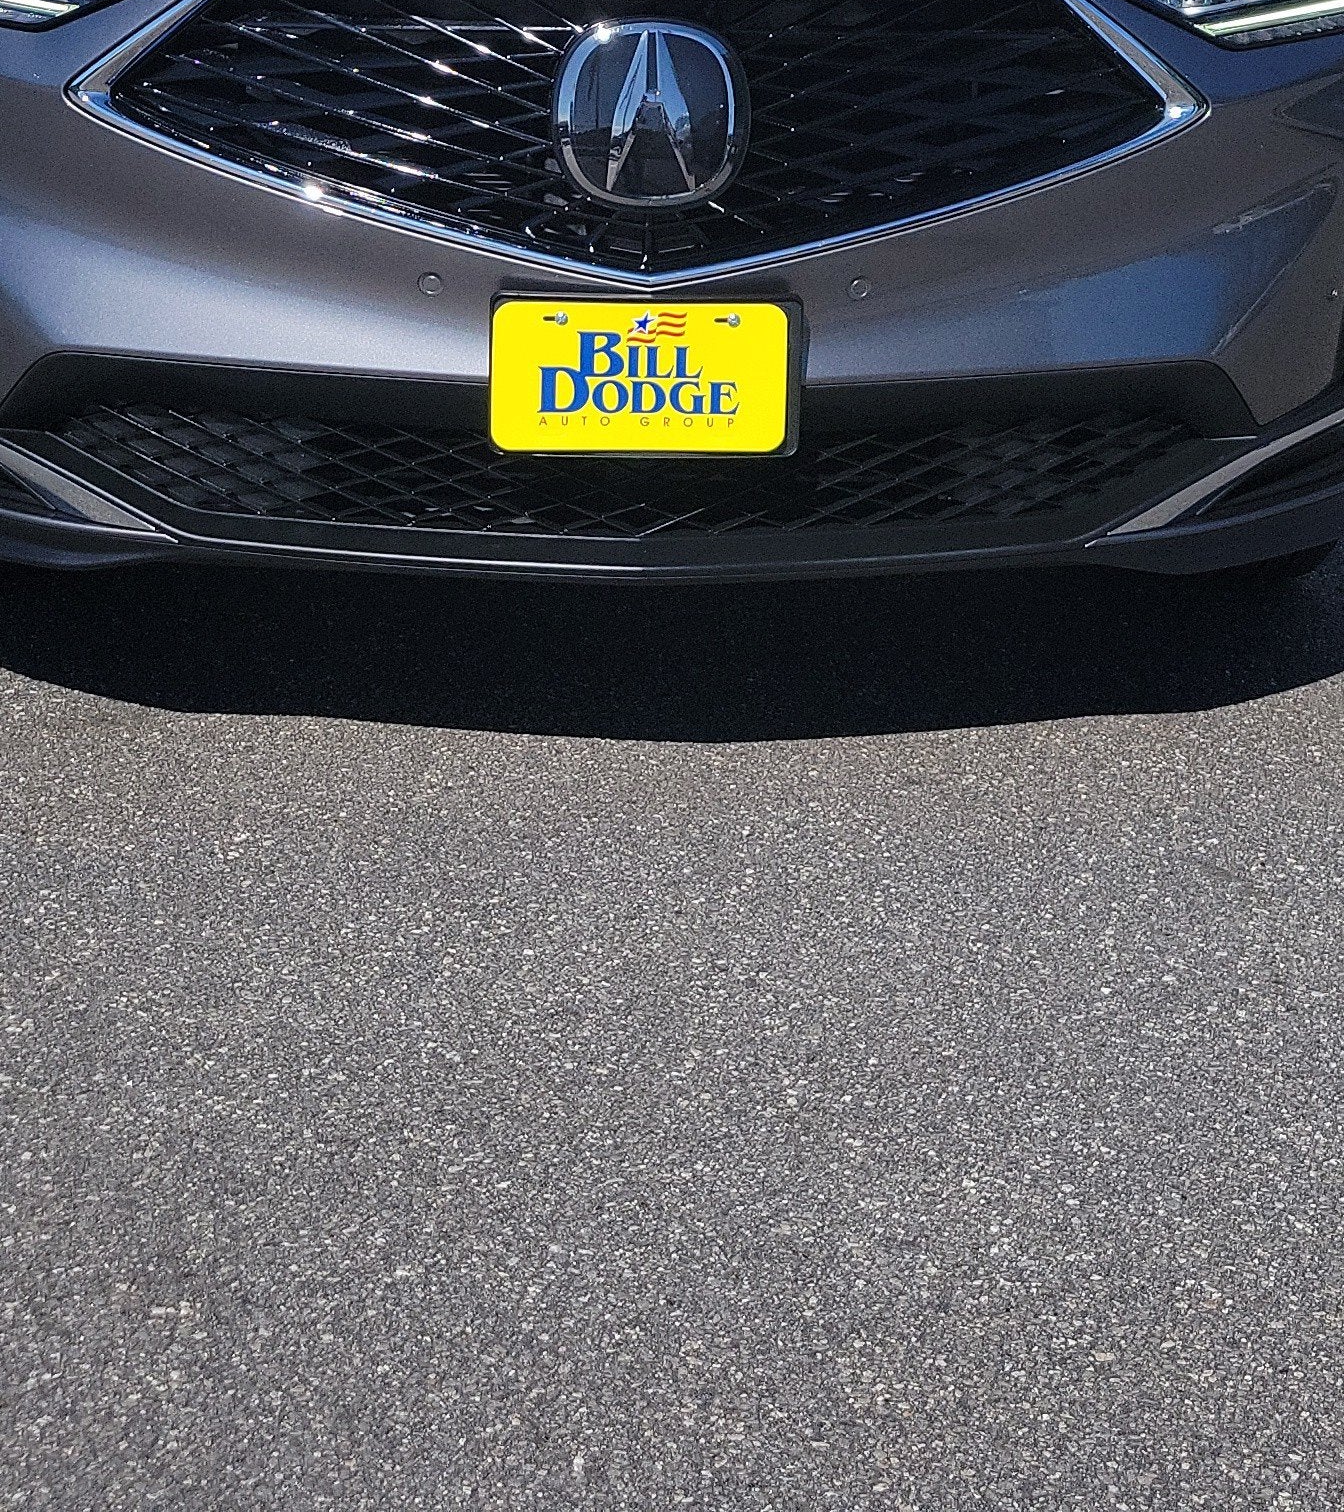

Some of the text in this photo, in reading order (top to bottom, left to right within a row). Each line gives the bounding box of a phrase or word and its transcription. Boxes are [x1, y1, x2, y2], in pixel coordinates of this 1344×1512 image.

[577, 330, 703, 379] BILL
[537, 365, 740, 416] DODGE
[539, 416, 735, 428] AUTO GROUP
